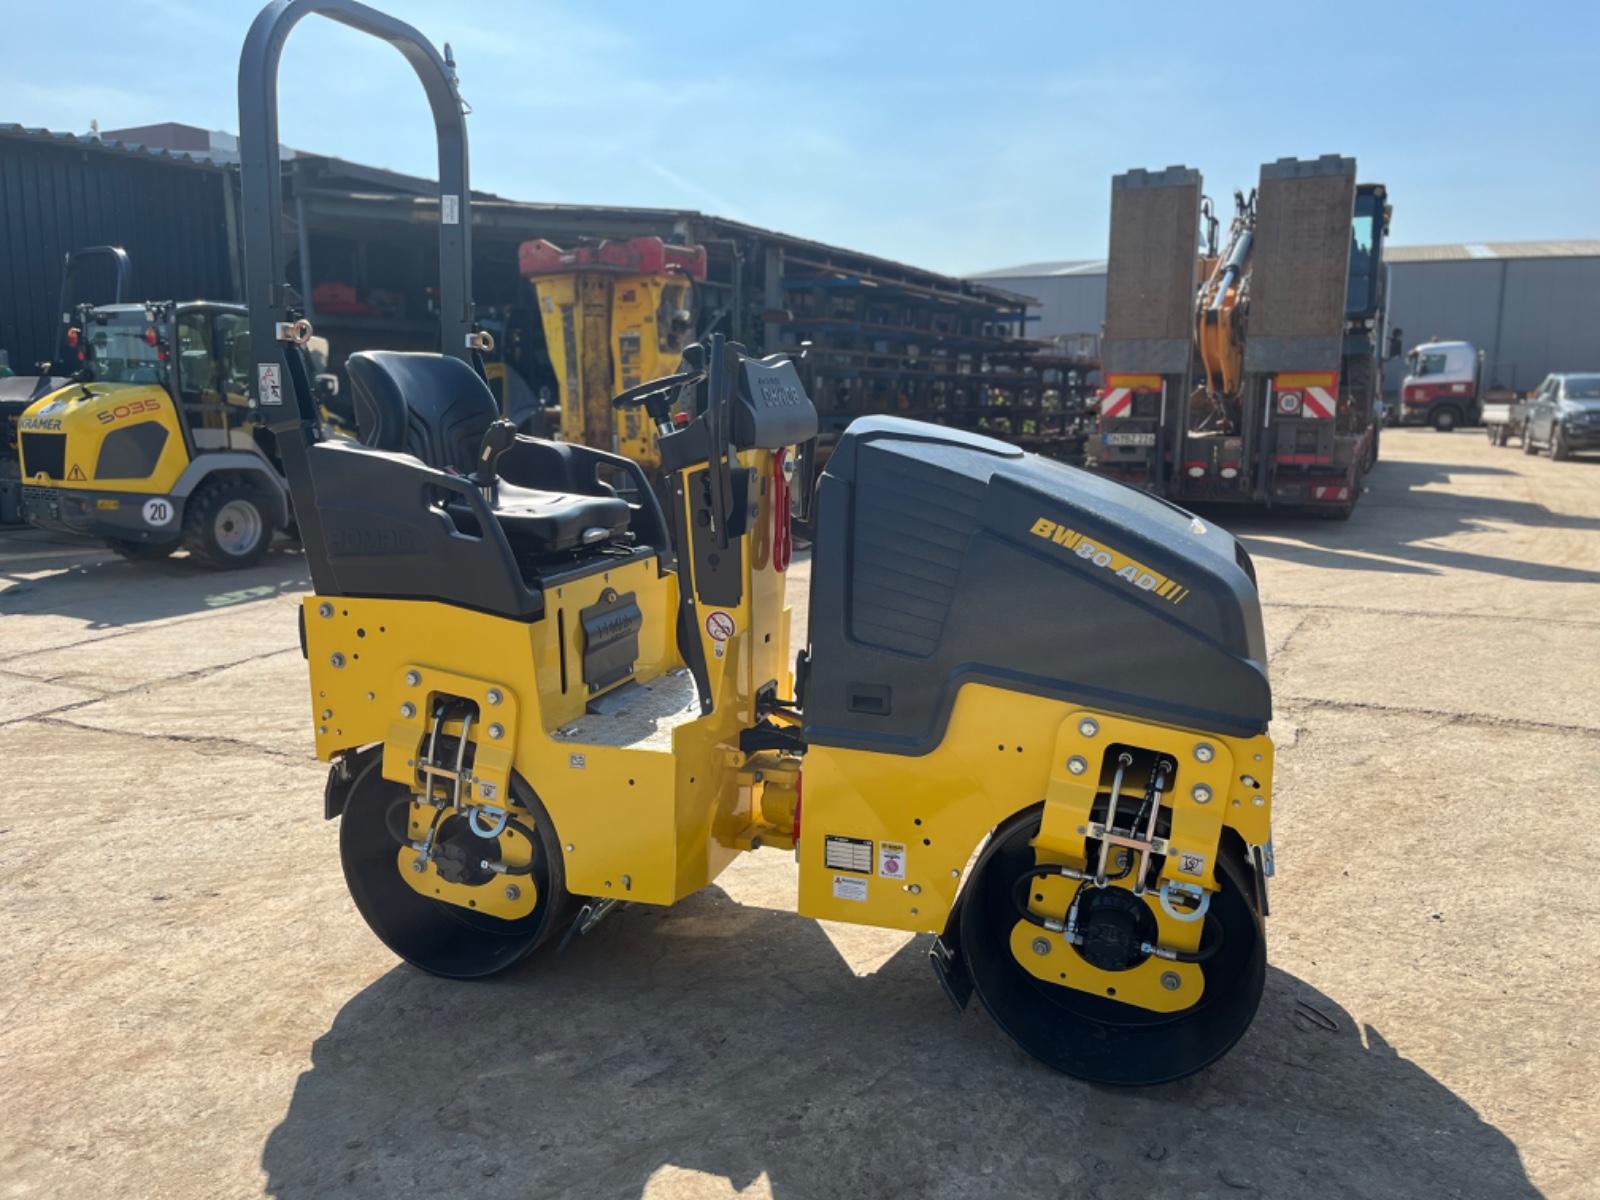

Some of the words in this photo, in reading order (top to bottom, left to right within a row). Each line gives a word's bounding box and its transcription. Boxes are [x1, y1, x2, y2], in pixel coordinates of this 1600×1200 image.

[97, 398, 161, 425] 5035
[150, 504, 167, 521] 20
[1116, 565, 1157, 591] AD
